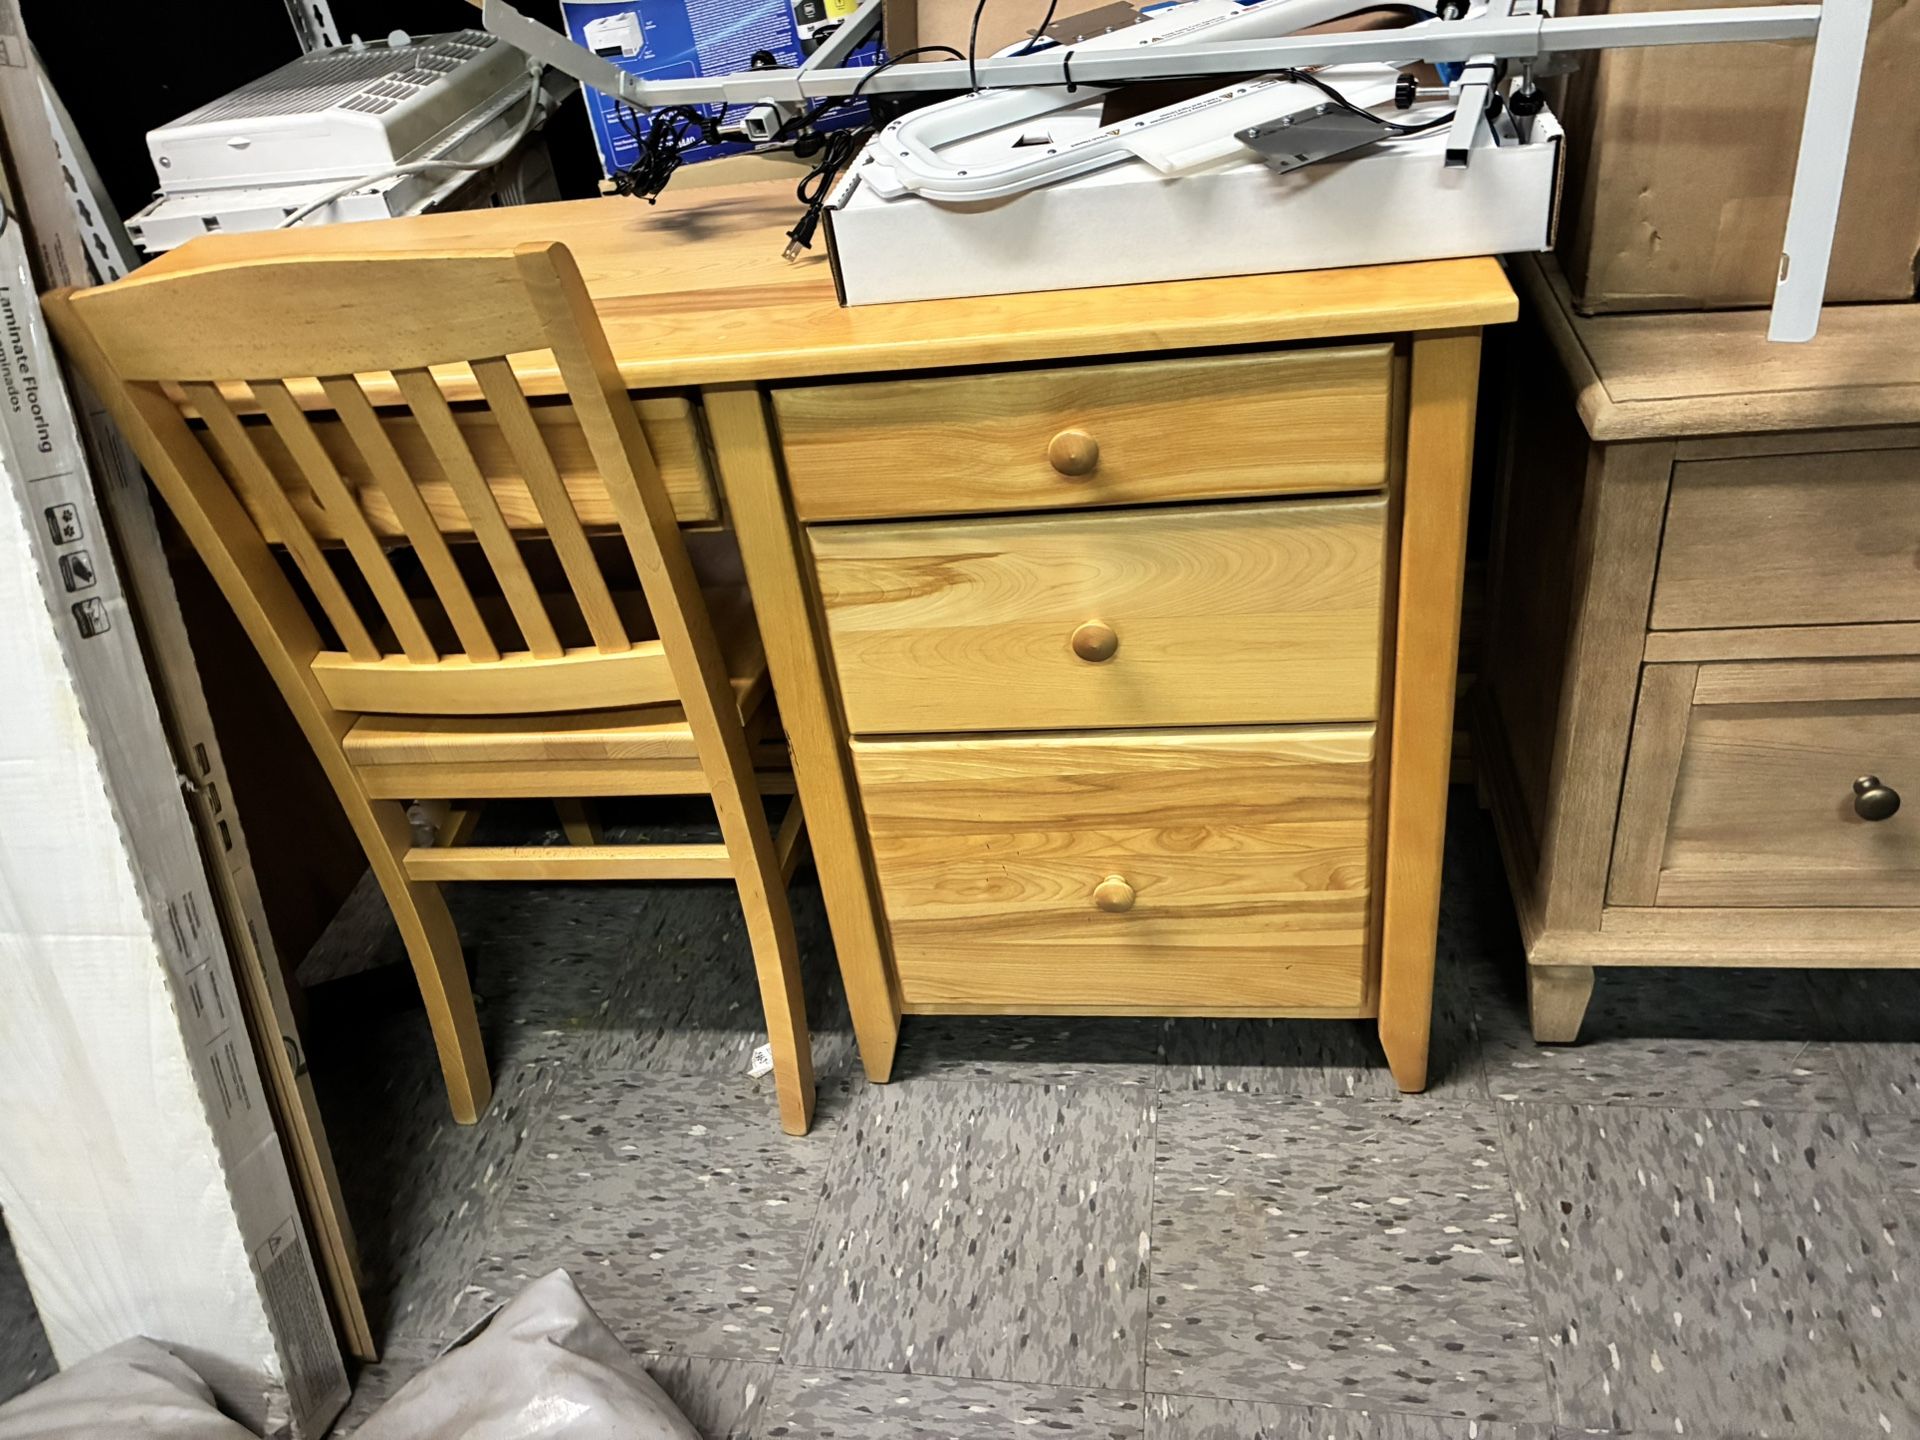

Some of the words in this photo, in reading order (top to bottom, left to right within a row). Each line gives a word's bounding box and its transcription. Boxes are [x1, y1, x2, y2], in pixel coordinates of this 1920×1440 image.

[0, 286, 29, 374] Laminate
[23, 376, 52, 454] Flooring
[0, 330, 21, 413] aminados
